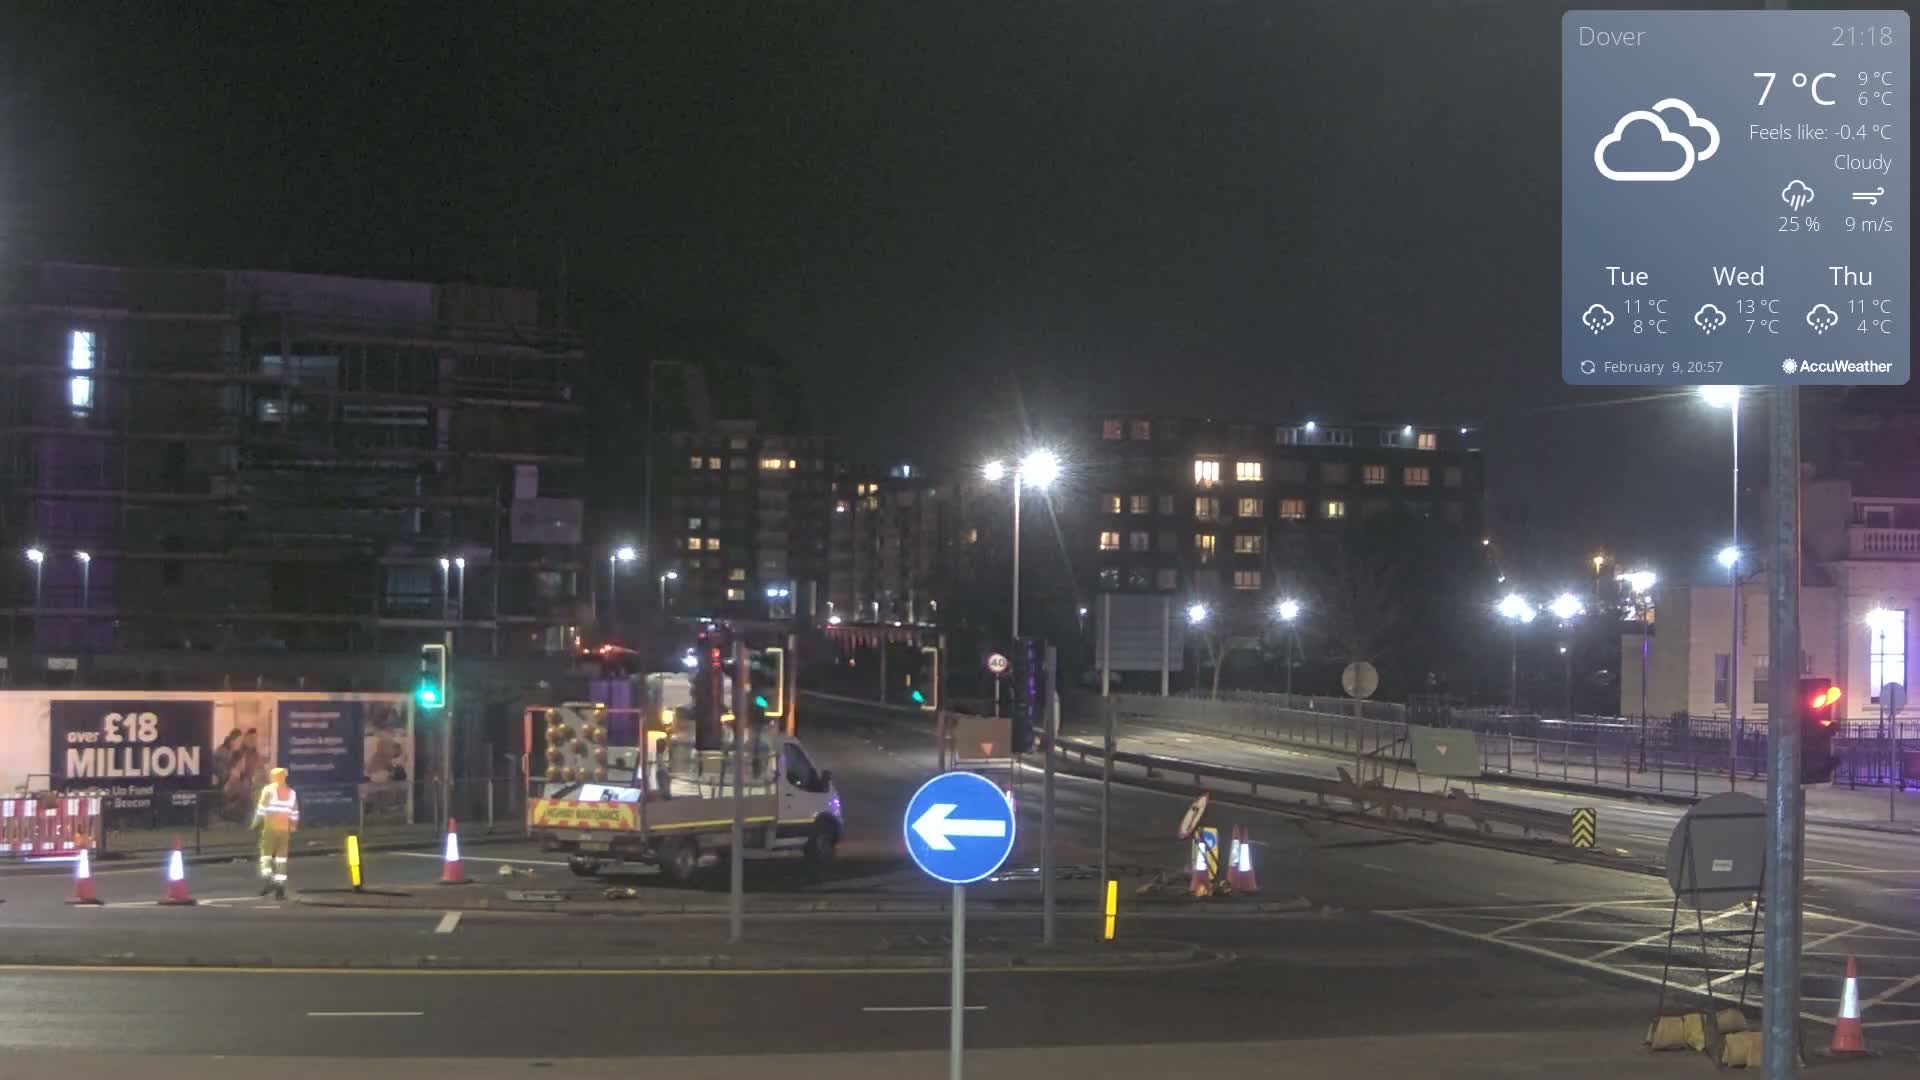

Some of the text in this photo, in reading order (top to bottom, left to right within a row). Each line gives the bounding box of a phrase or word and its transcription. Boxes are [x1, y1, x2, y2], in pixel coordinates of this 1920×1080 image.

[991, 659, 1004, 667] 40
[67, 712, 158, 743] over £18
[66, 746, 200, 778] MILLION
